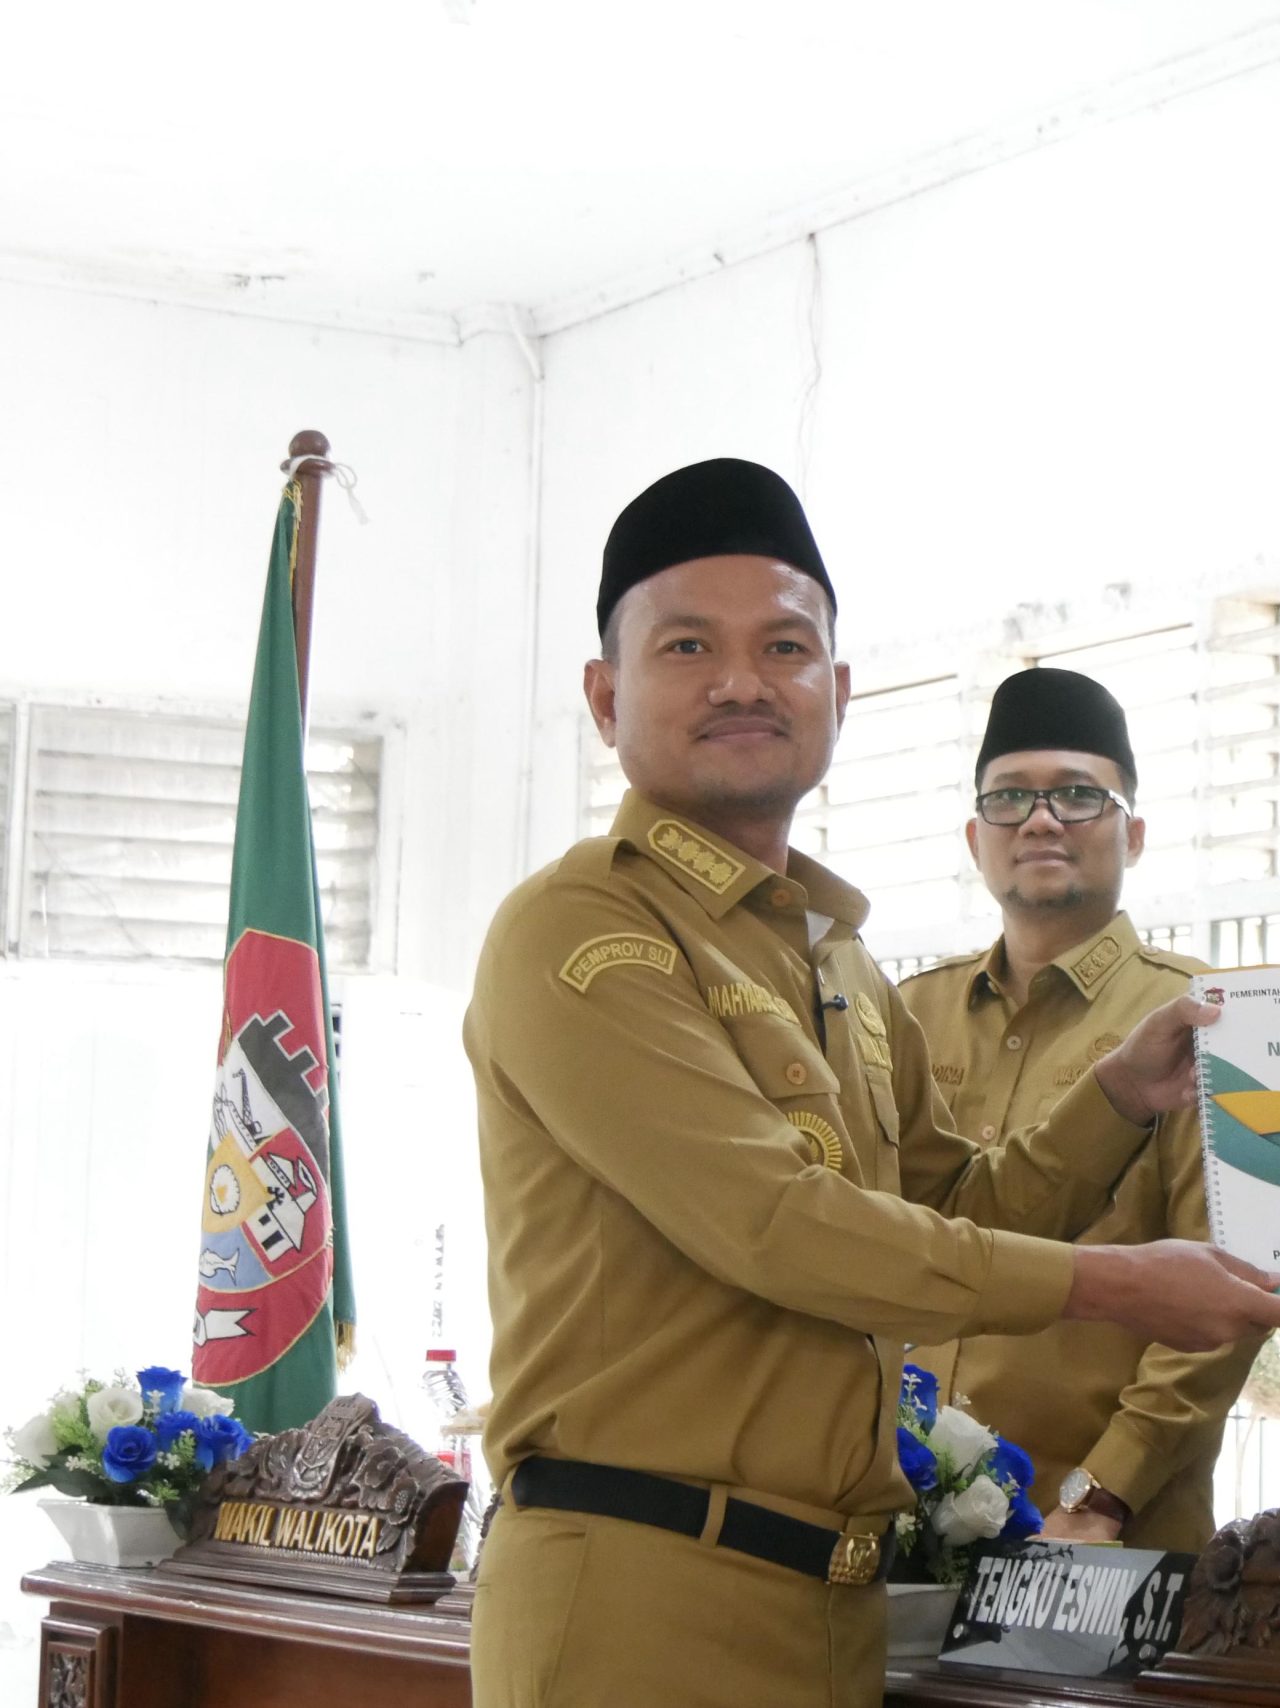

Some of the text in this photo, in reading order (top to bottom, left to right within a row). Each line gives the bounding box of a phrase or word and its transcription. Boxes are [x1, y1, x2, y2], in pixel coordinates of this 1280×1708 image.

[572, 941, 668, 981] PEMPROV SU
[214, 1502, 379, 1558] WAKIL WALIKOTA
[966, 1556, 1065, 1630] TENGKU
[1133, 1571, 1184, 1643] S.T.
